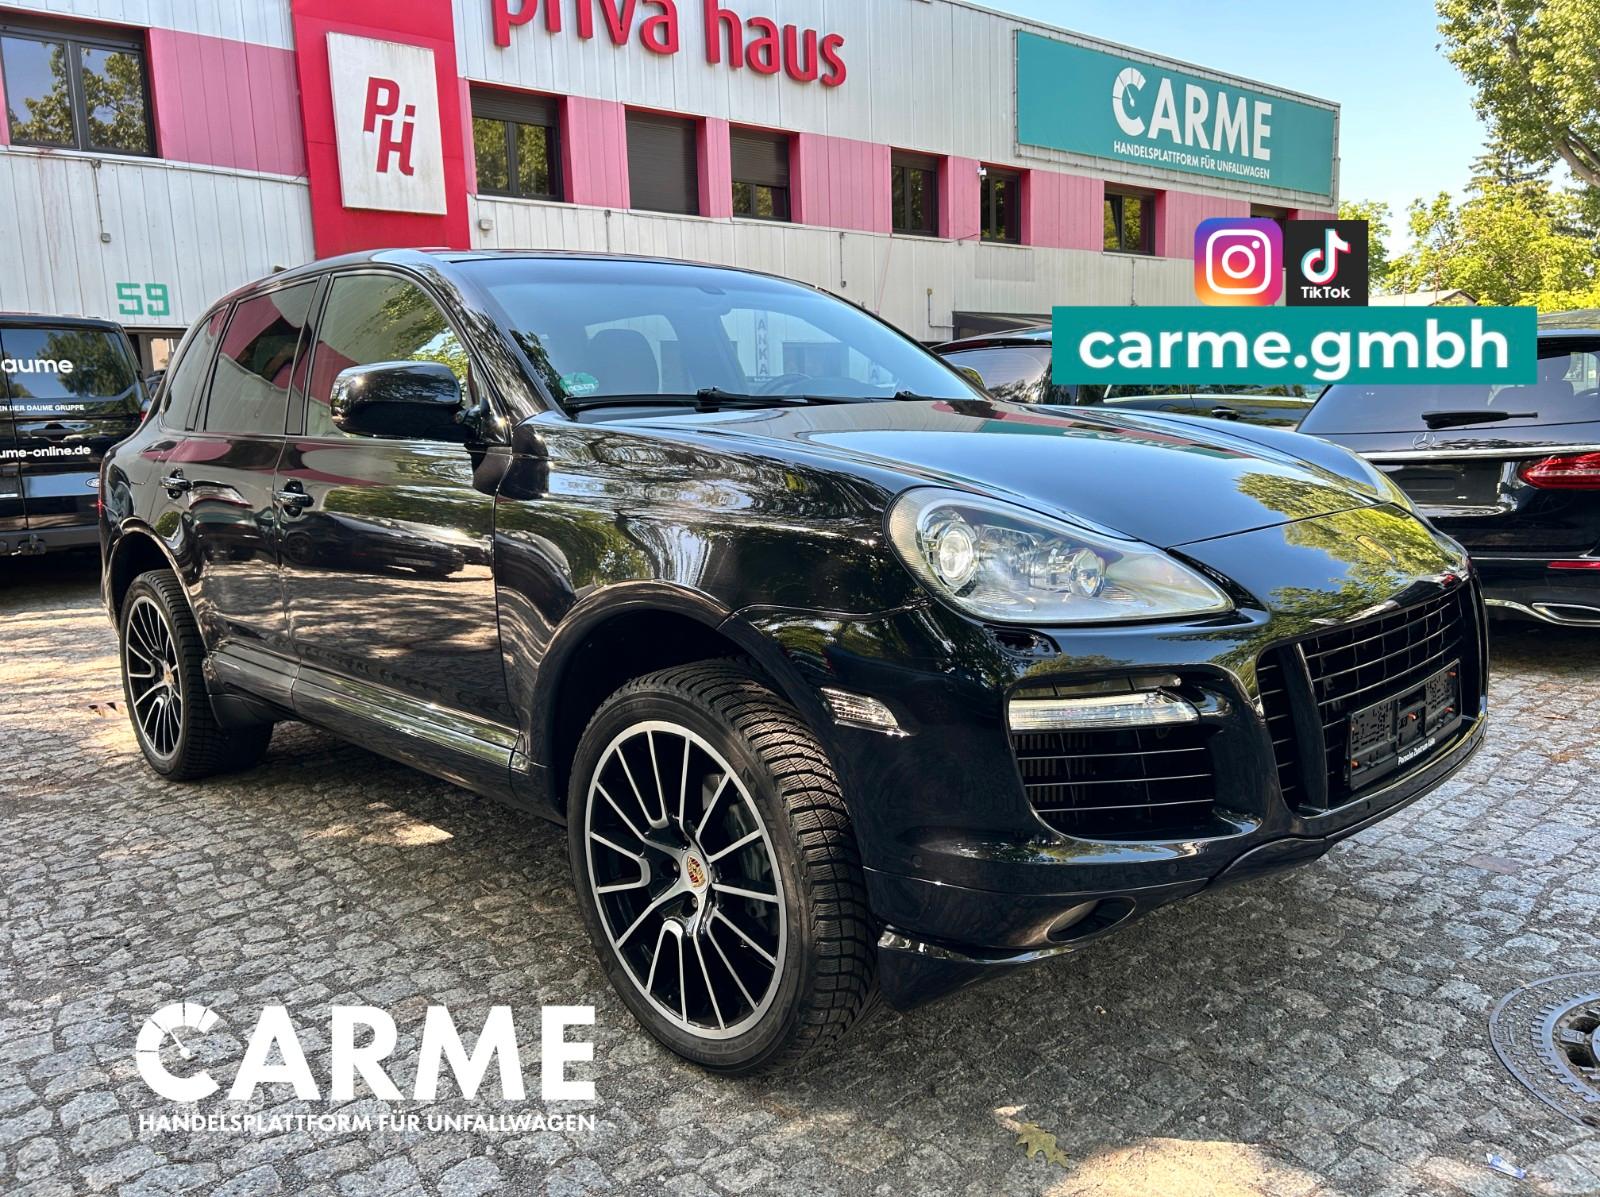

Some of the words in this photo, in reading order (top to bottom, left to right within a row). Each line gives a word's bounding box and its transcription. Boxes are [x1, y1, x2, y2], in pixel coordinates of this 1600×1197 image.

[704, 0, 847, 87] haus
[1112, 67, 1273, 161] CARME
[1113, 140, 1199, 168] HANDELSPLATTFORM
[1200, 154, 1216, 171] FÜR
[1217, 160, 1270, 180] UNFALLWAGEN
[116, 282, 169, 316] 59
